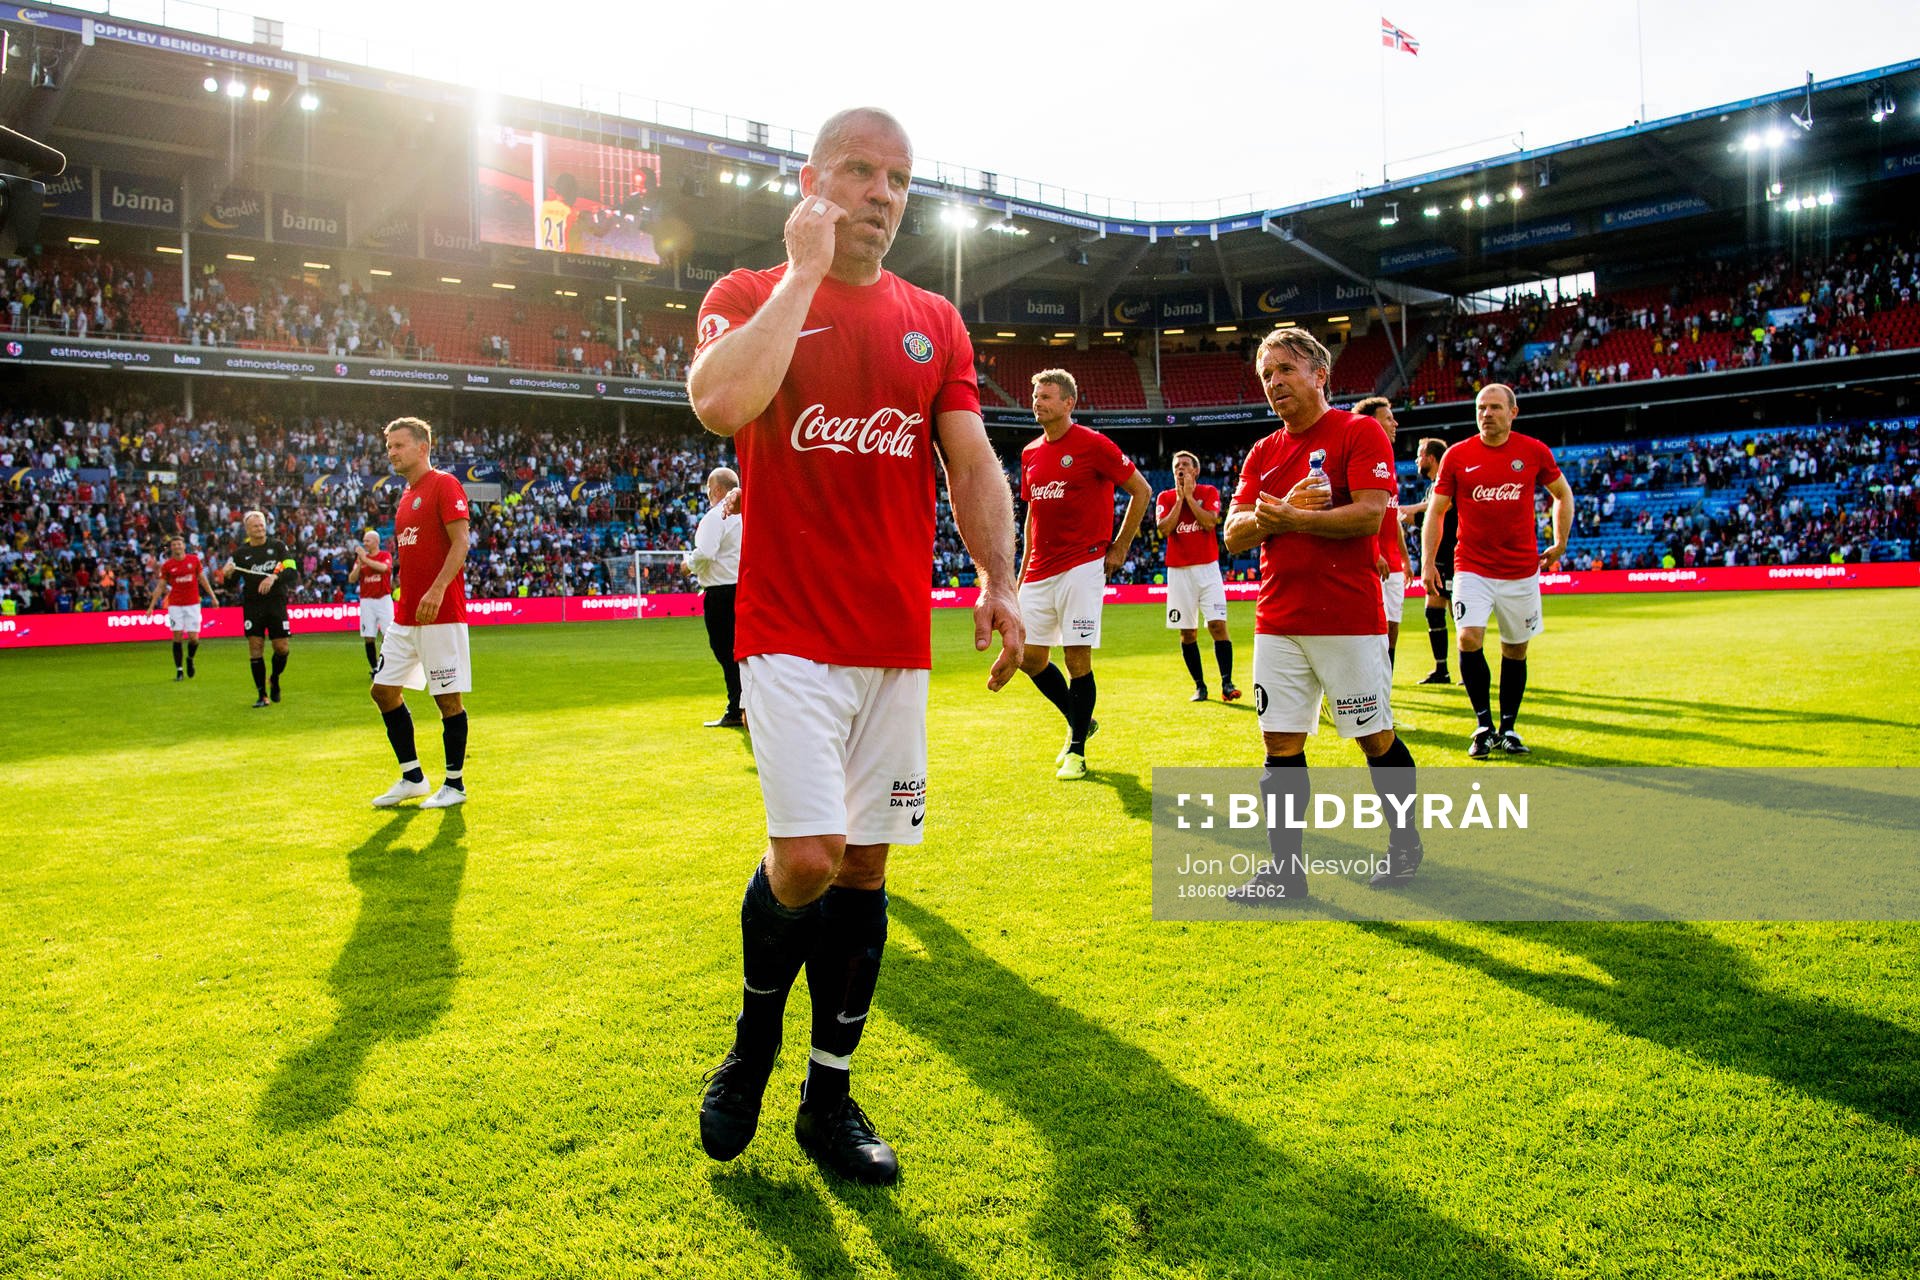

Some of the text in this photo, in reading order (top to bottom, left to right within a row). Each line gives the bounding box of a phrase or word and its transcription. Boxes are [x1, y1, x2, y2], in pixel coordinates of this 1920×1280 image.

[94, 23, 294, 71] OPPLEV BENDIT-EFFEKTEN
[45, 175, 84, 195] endit
[112, 186, 175, 214] bama
[282, 208, 338, 234] bama
[1618, 206, 1658, 222] NORSK
[543, 216, 566, 250] 21
[1492, 231, 1529, 246] NORSK
[1027, 300, 1065, 315] bama
[1163, 303, 1203, 317] bama
[51, 346, 150, 362] eatmovesleep.no
[227, 358, 315, 373] eatmovesleep.no
[369, 367, 449, 382] eatmovesleep.no
[509, 377, 579, 391] eatmovesleep.no
[624, 386, 687, 398] eatmovesleep.no
[1191, 411, 1252, 423] eatmovesleep.no
[791, 403, 924, 458] Coca-Cola
[1472, 483, 1524, 502] Coca-Cola
[1539, 573, 1571, 585] egian
[1628, 570, 1697, 583] norwegian
[1769, 565, 1846, 578] norwegian
[582, 596, 648, 610] norwegian
[1336, 694, 1377, 705] BACALHAU
[1348, 706, 1378, 715] NORUEGA
[890, 799, 903, 807] DA
